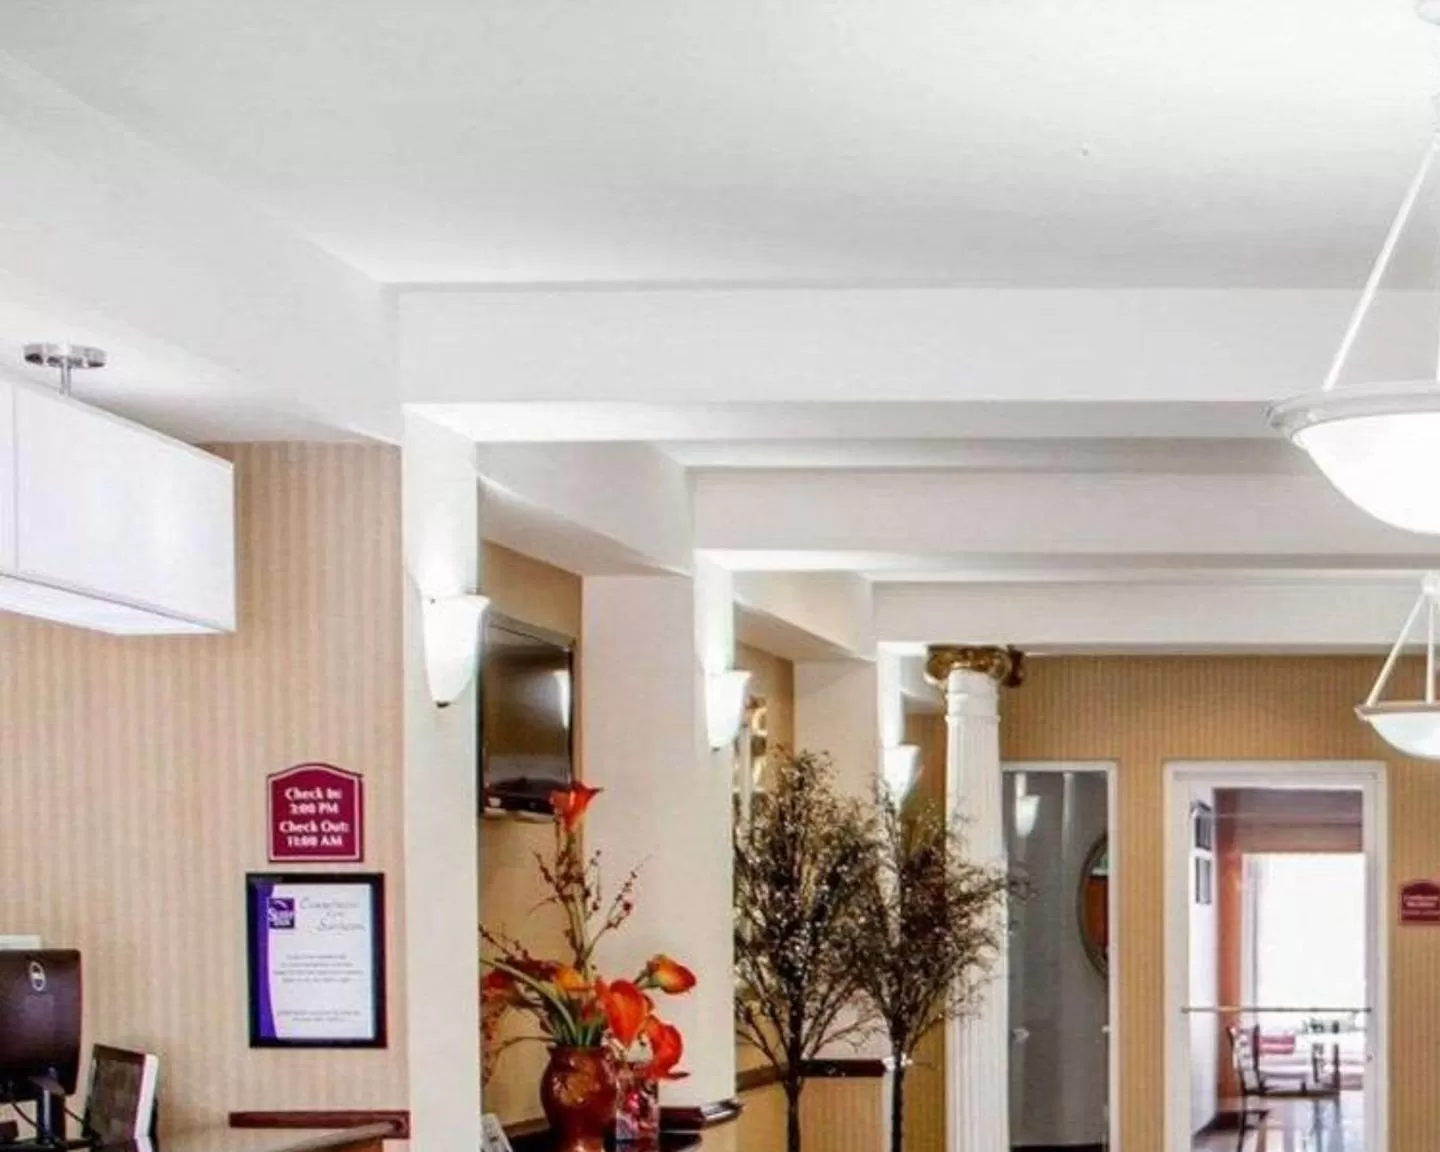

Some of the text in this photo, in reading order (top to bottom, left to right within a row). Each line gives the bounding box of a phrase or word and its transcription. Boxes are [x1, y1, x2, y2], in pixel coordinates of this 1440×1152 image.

[284, 787, 323, 800] Check
[318, 802, 339, 814] PM
[279, 820, 350, 833] Check Out:
[320, 835, 343, 847] AM
